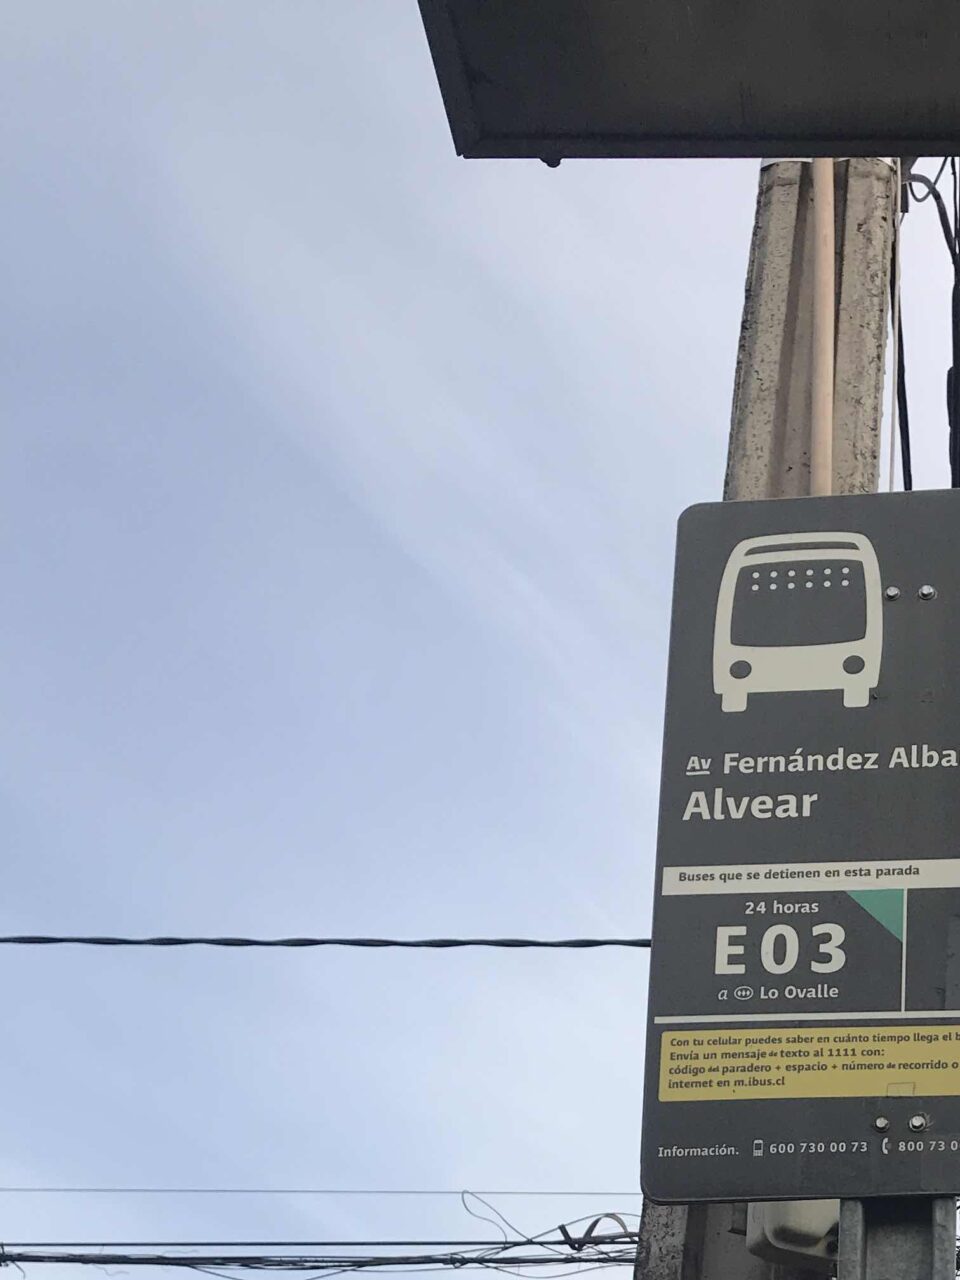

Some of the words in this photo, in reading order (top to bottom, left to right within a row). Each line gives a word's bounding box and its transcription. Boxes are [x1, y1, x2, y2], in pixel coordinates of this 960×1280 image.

[686, 756, 712, 775] Av
[723, 747, 879, 775] Fernández
[682, 787, 818, 821] Alvear
[678, 871, 715, 883] Buses
[719, 870, 743, 883] que
[746, 871, 760, 880] se
[764, 867, 821, 880] detienen
[824, 869, 840, 879] en
[844, 867, 871, 878] esta
[876, 864, 920, 880] parada
[745, 901, 767, 915] 24
[773, 900, 819, 914] horas
[714, 922, 847, 975] E03
[717, 989, 728, 1001] a
[759, 985, 779, 999] Lo
[784, 983, 839, 998] Ovalle
[670, 1037, 690, 1047] Con
[693, 1038, 704, 1046] tu
[707, 1035, 742, 1046] celular
[744, 1034, 783, 1047] puedes
[785, 1033, 815, 1044] saber
[817, 1035, 830, 1043] en
[833, 1032, 870, 1043] cuánto
[872, 1032, 910, 1044] tiempo
[913, 1031, 939, 1044] llega
[942, 1031, 952, 1042] el
[669, 1049, 700, 1061] Envía
[703, 1051, 717, 1060] un
[720, 1049, 767, 1062] mensaje
[780, 1049, 810, 1058] texto
[813, 1047, 824, 1058] al
[827, 1047, 857, 1057] 1111
[860, 1047, 885, 1057] con:
[668, 1063, 706, 1077] código
[721, 1062, 772, 1076] paradero
[785, 1061, 828, 1074] espacio
[841, 1059, 885, 1071] número
[898, 1059, 949, 1070] recorrido
[951, 1061, 959, 1069] o
[668, 1078, 713, 1089] internet
[716, 1079, 730, 1088] en
[733, 1076, 785, 1088] m.ibus.cl
[657, 1143, 740, 1157] Información.
[769, 1143, 795, 1154] 600
[799, 1142, 825, 1153] 730
[829, 1142, 847, 1153] 00
[851, 1141, 868, 1152] 73
[898, 1140, 924, 1152] 800
[929, 1140, 946, 1151] 73
